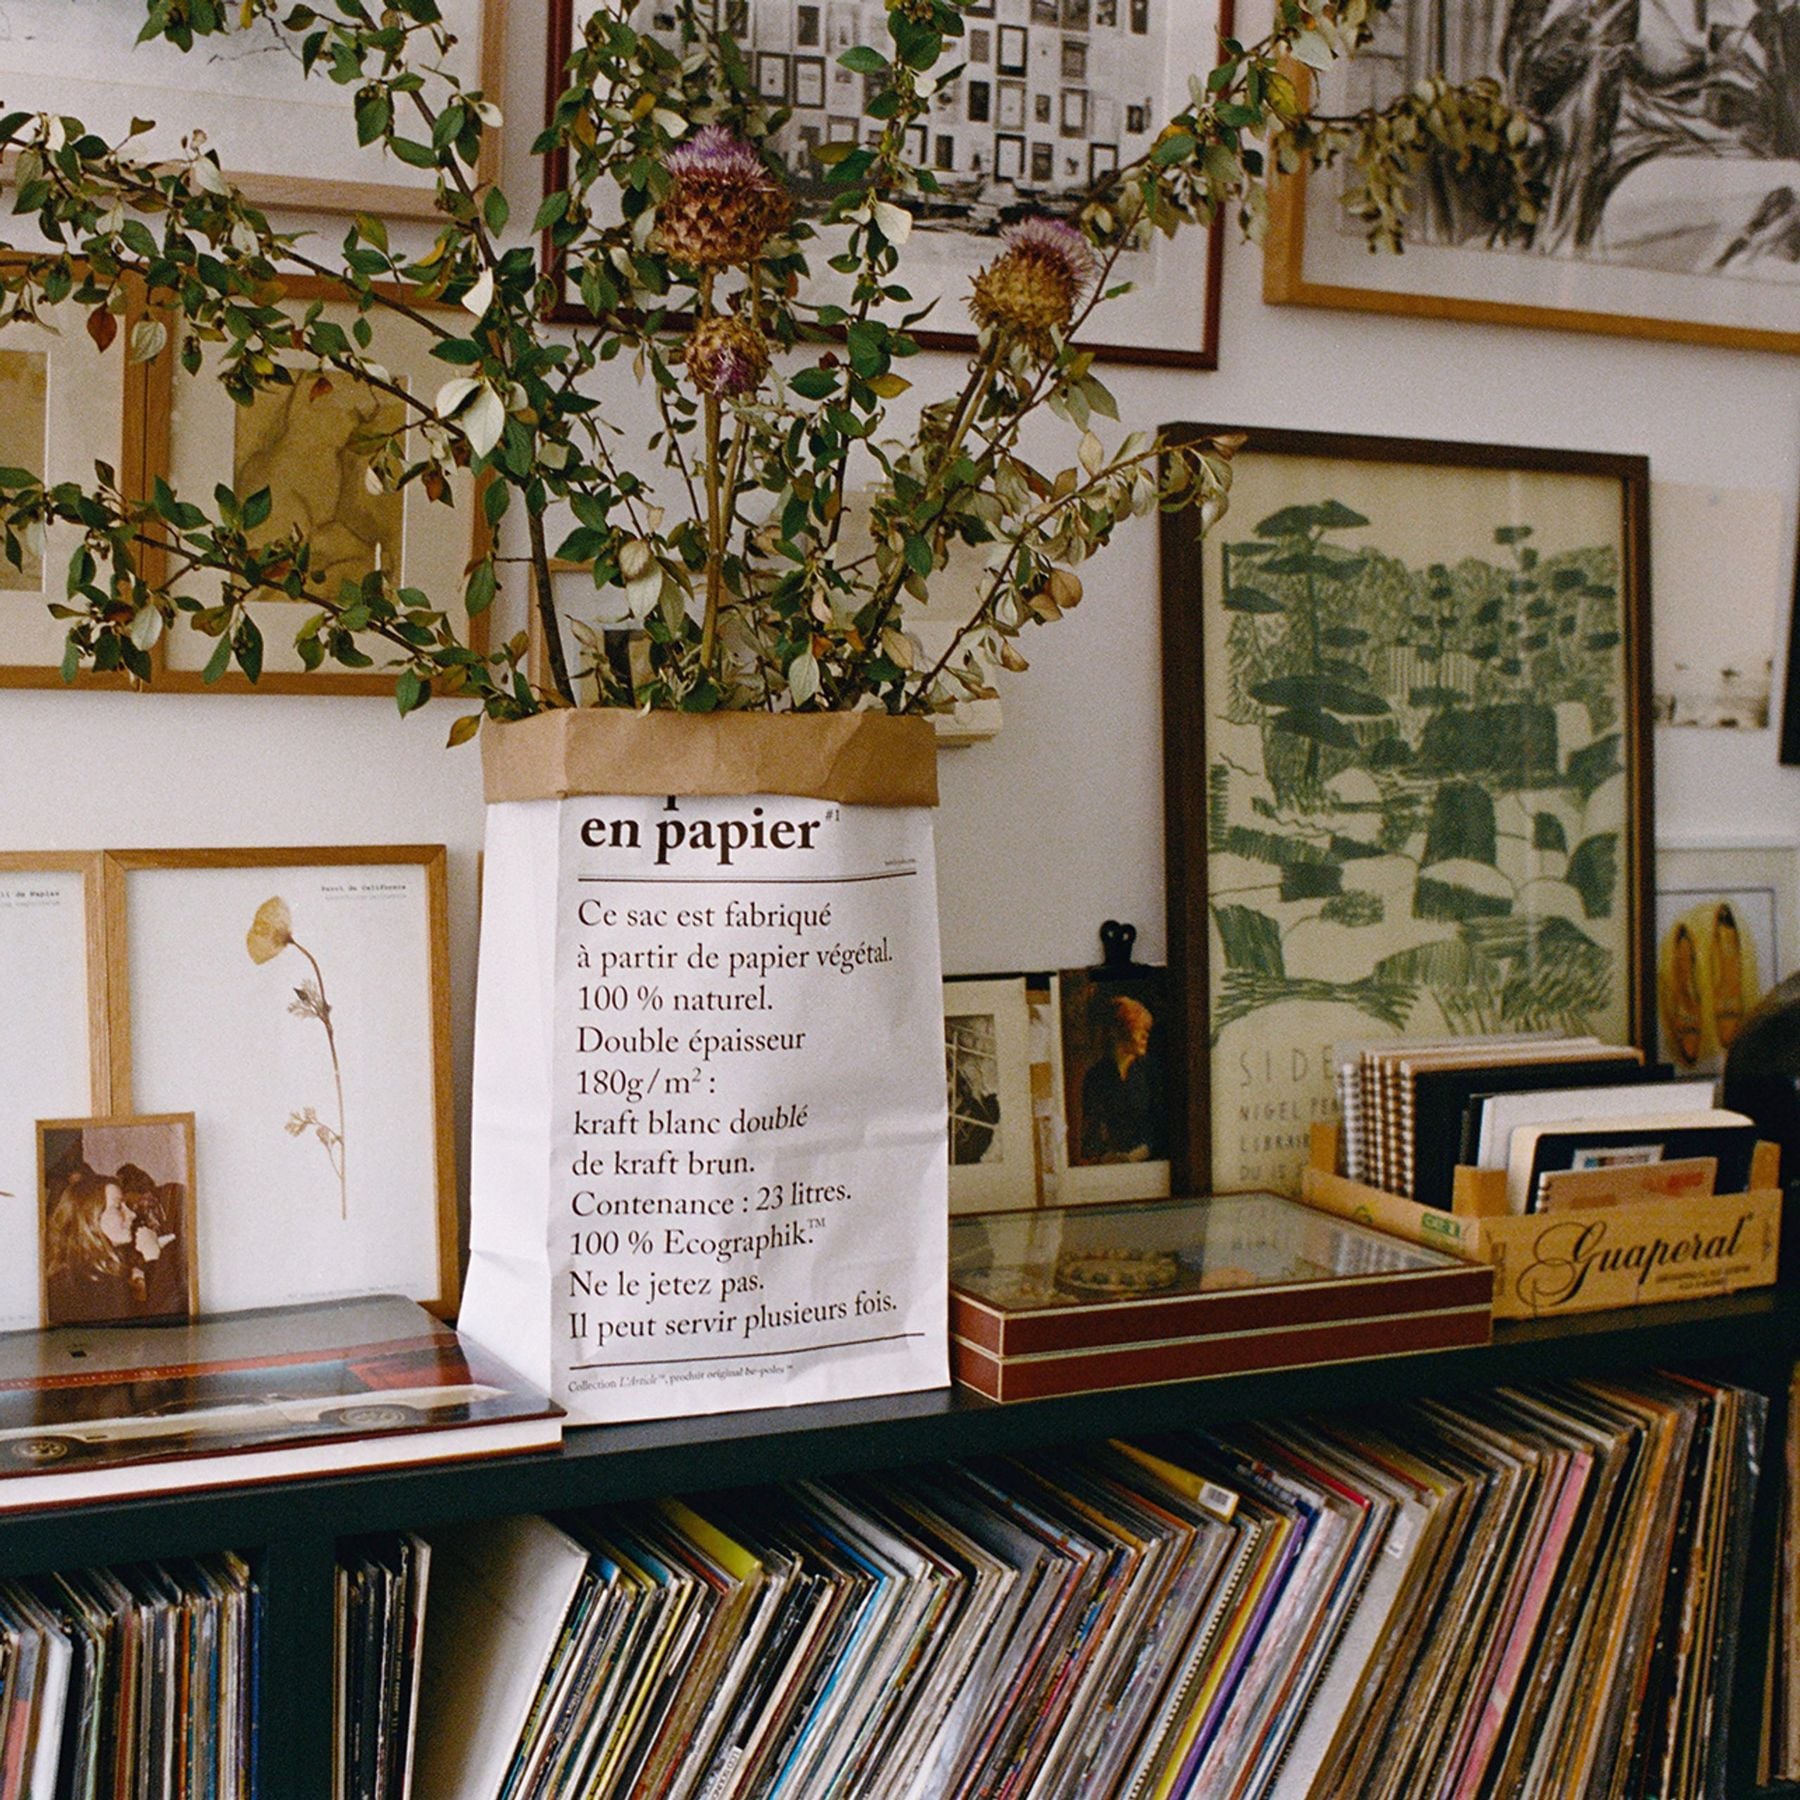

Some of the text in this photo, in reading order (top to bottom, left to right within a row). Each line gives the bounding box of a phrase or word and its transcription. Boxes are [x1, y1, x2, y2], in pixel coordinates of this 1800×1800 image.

[581, 818, 641, 848] en
[653, 807, 820, 866] papier
[578, 899, 831, 936] Ce sac est fabriqué
[578, 937, 892, 978] à partir de papier végétal.
[579, 984, 772, 1011] 100 % naturel.
[576, 1026, 806, 1062] Double épaisseur
[573, 1104, 808, 1135] kraft blanc doublé
[572, 1150, 754, 1176] de kraft brun.
[572, 1191, 734, 1217] Contenance
[756, 1185, 783, 1211] 23
[790, 1181, 851, 1206] litres.
[571, 1231, 619, 1255] 100
[628, 1230, 653, 1254] %
[1516, 1216, 1747, 1306] Guaperal
[568, 1270, 764, 1305] Ne le jetez pas.
[568, 1290, 897, 1347] Il peut servir plusieurs fois.
[568, 1379, 617, 1393] Collection
